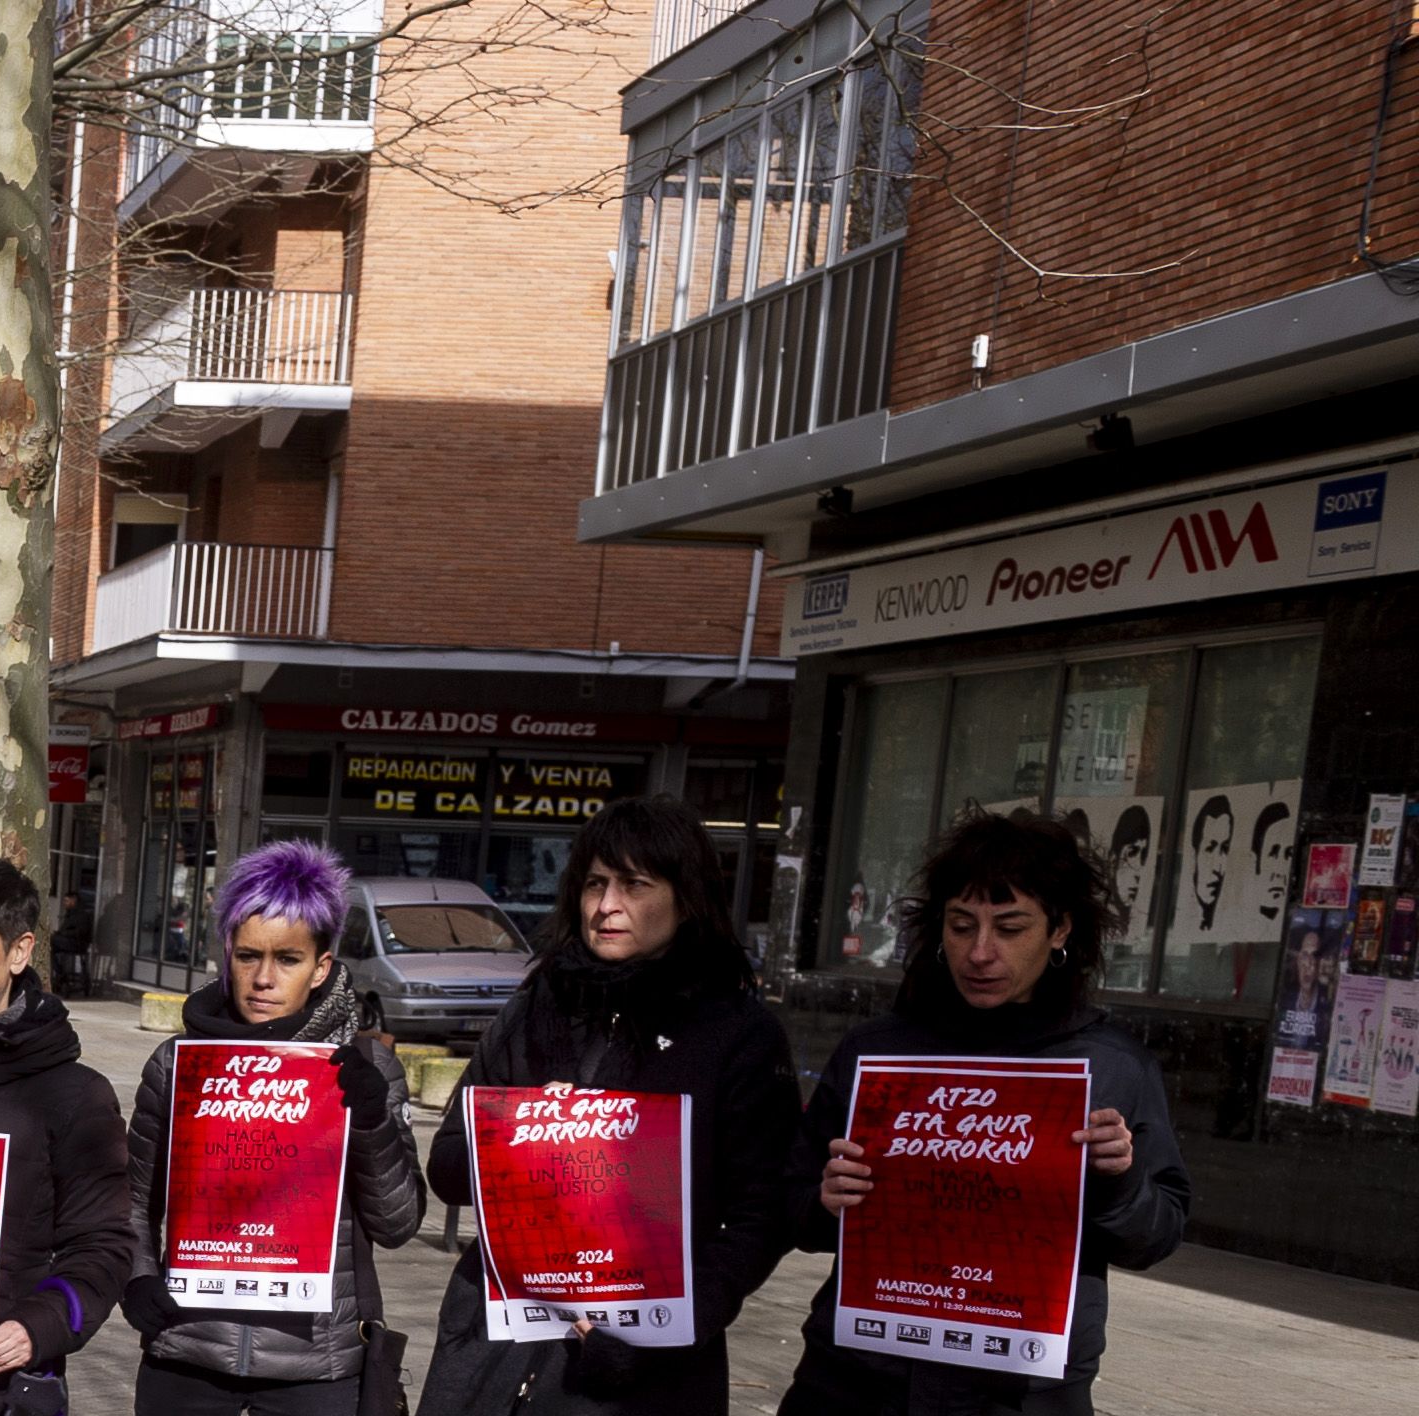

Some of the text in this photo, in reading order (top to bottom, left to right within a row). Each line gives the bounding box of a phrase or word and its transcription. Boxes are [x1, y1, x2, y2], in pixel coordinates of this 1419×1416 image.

[1322, 488, 1379, 515] SONY
[1318, 543, 1338, 558] Sony
[986, 556, 1131, 606] Pioneer
[875, 575, 969, 623] KENWOOD
[341, 709, 597, 737] CALZADOS Gomez
[1064, 703, 1091, 730] SE
[500, 764, 515, 784] Y
[530, 765, 614, 788] VENTA
[1058, 755, 1136, 782] VENDE
[374, 789, 417, 811] DE
[225, 1056, 282, 1076] ATZO
[202, 1078, 309, 1101] ETA GAUR
[927, 1086, 997, 1111] ATZO
[195, 1098, 311, 1124] BORROKAN
[515, 1098, 637, 1121] ETA GAUR
[509, 1112, 639, 1147] BORROKAN
[893, 1112, 1032, 1138] ETA GAUR
[883, 1134, 1034, 1164] BORROKAN
[239, 1223, 274, 1236] 2024
[178, 1240, 252, 1253] MARTXOAK 3
[576, 1249, 614, 1265] 2024
[523, 1270, 593, 1284] MARTXOAK 3
[951, 1266, 993, 1283] 2024
[876, 1279, 966, 1300] MARTXOAK 3
